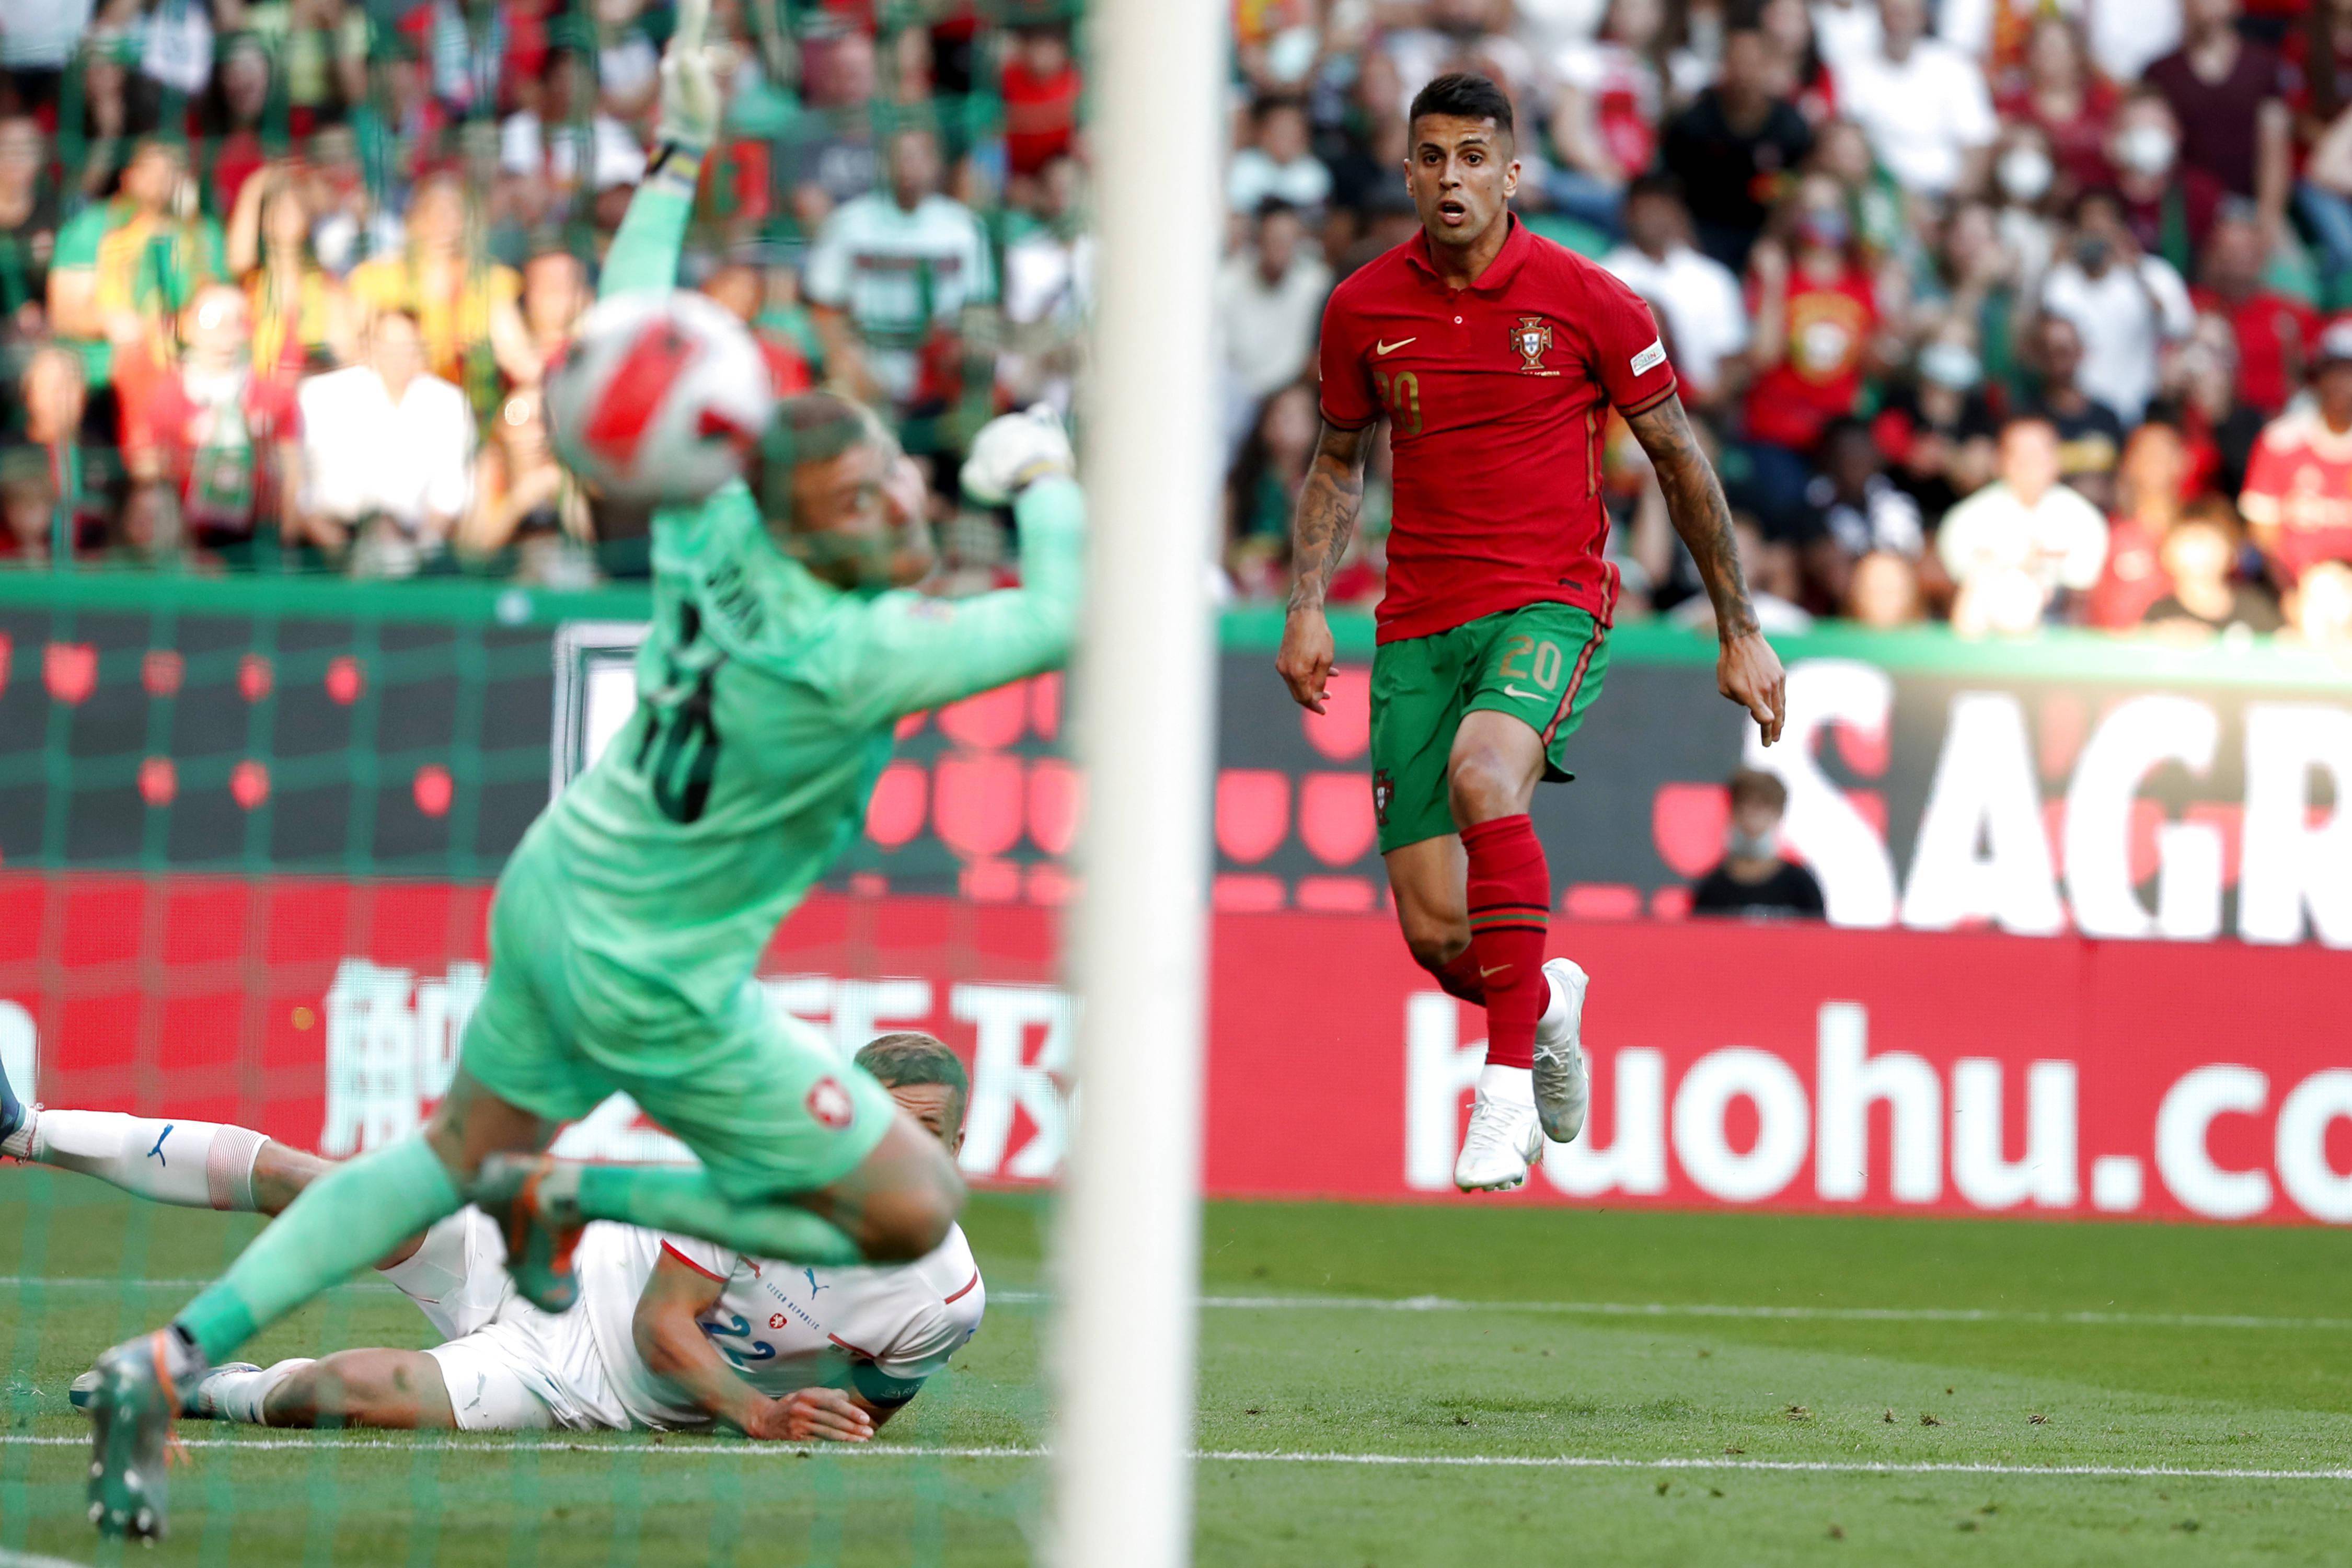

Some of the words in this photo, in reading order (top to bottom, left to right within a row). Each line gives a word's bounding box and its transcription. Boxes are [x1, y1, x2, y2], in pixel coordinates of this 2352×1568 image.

[1498, 633, 1562, 691] 20
[766, 1283, 787, 1303] CZECH
[787, 1302, 820, 1330] REPUBLIC
[701, 1314, 776, 1367] 22
